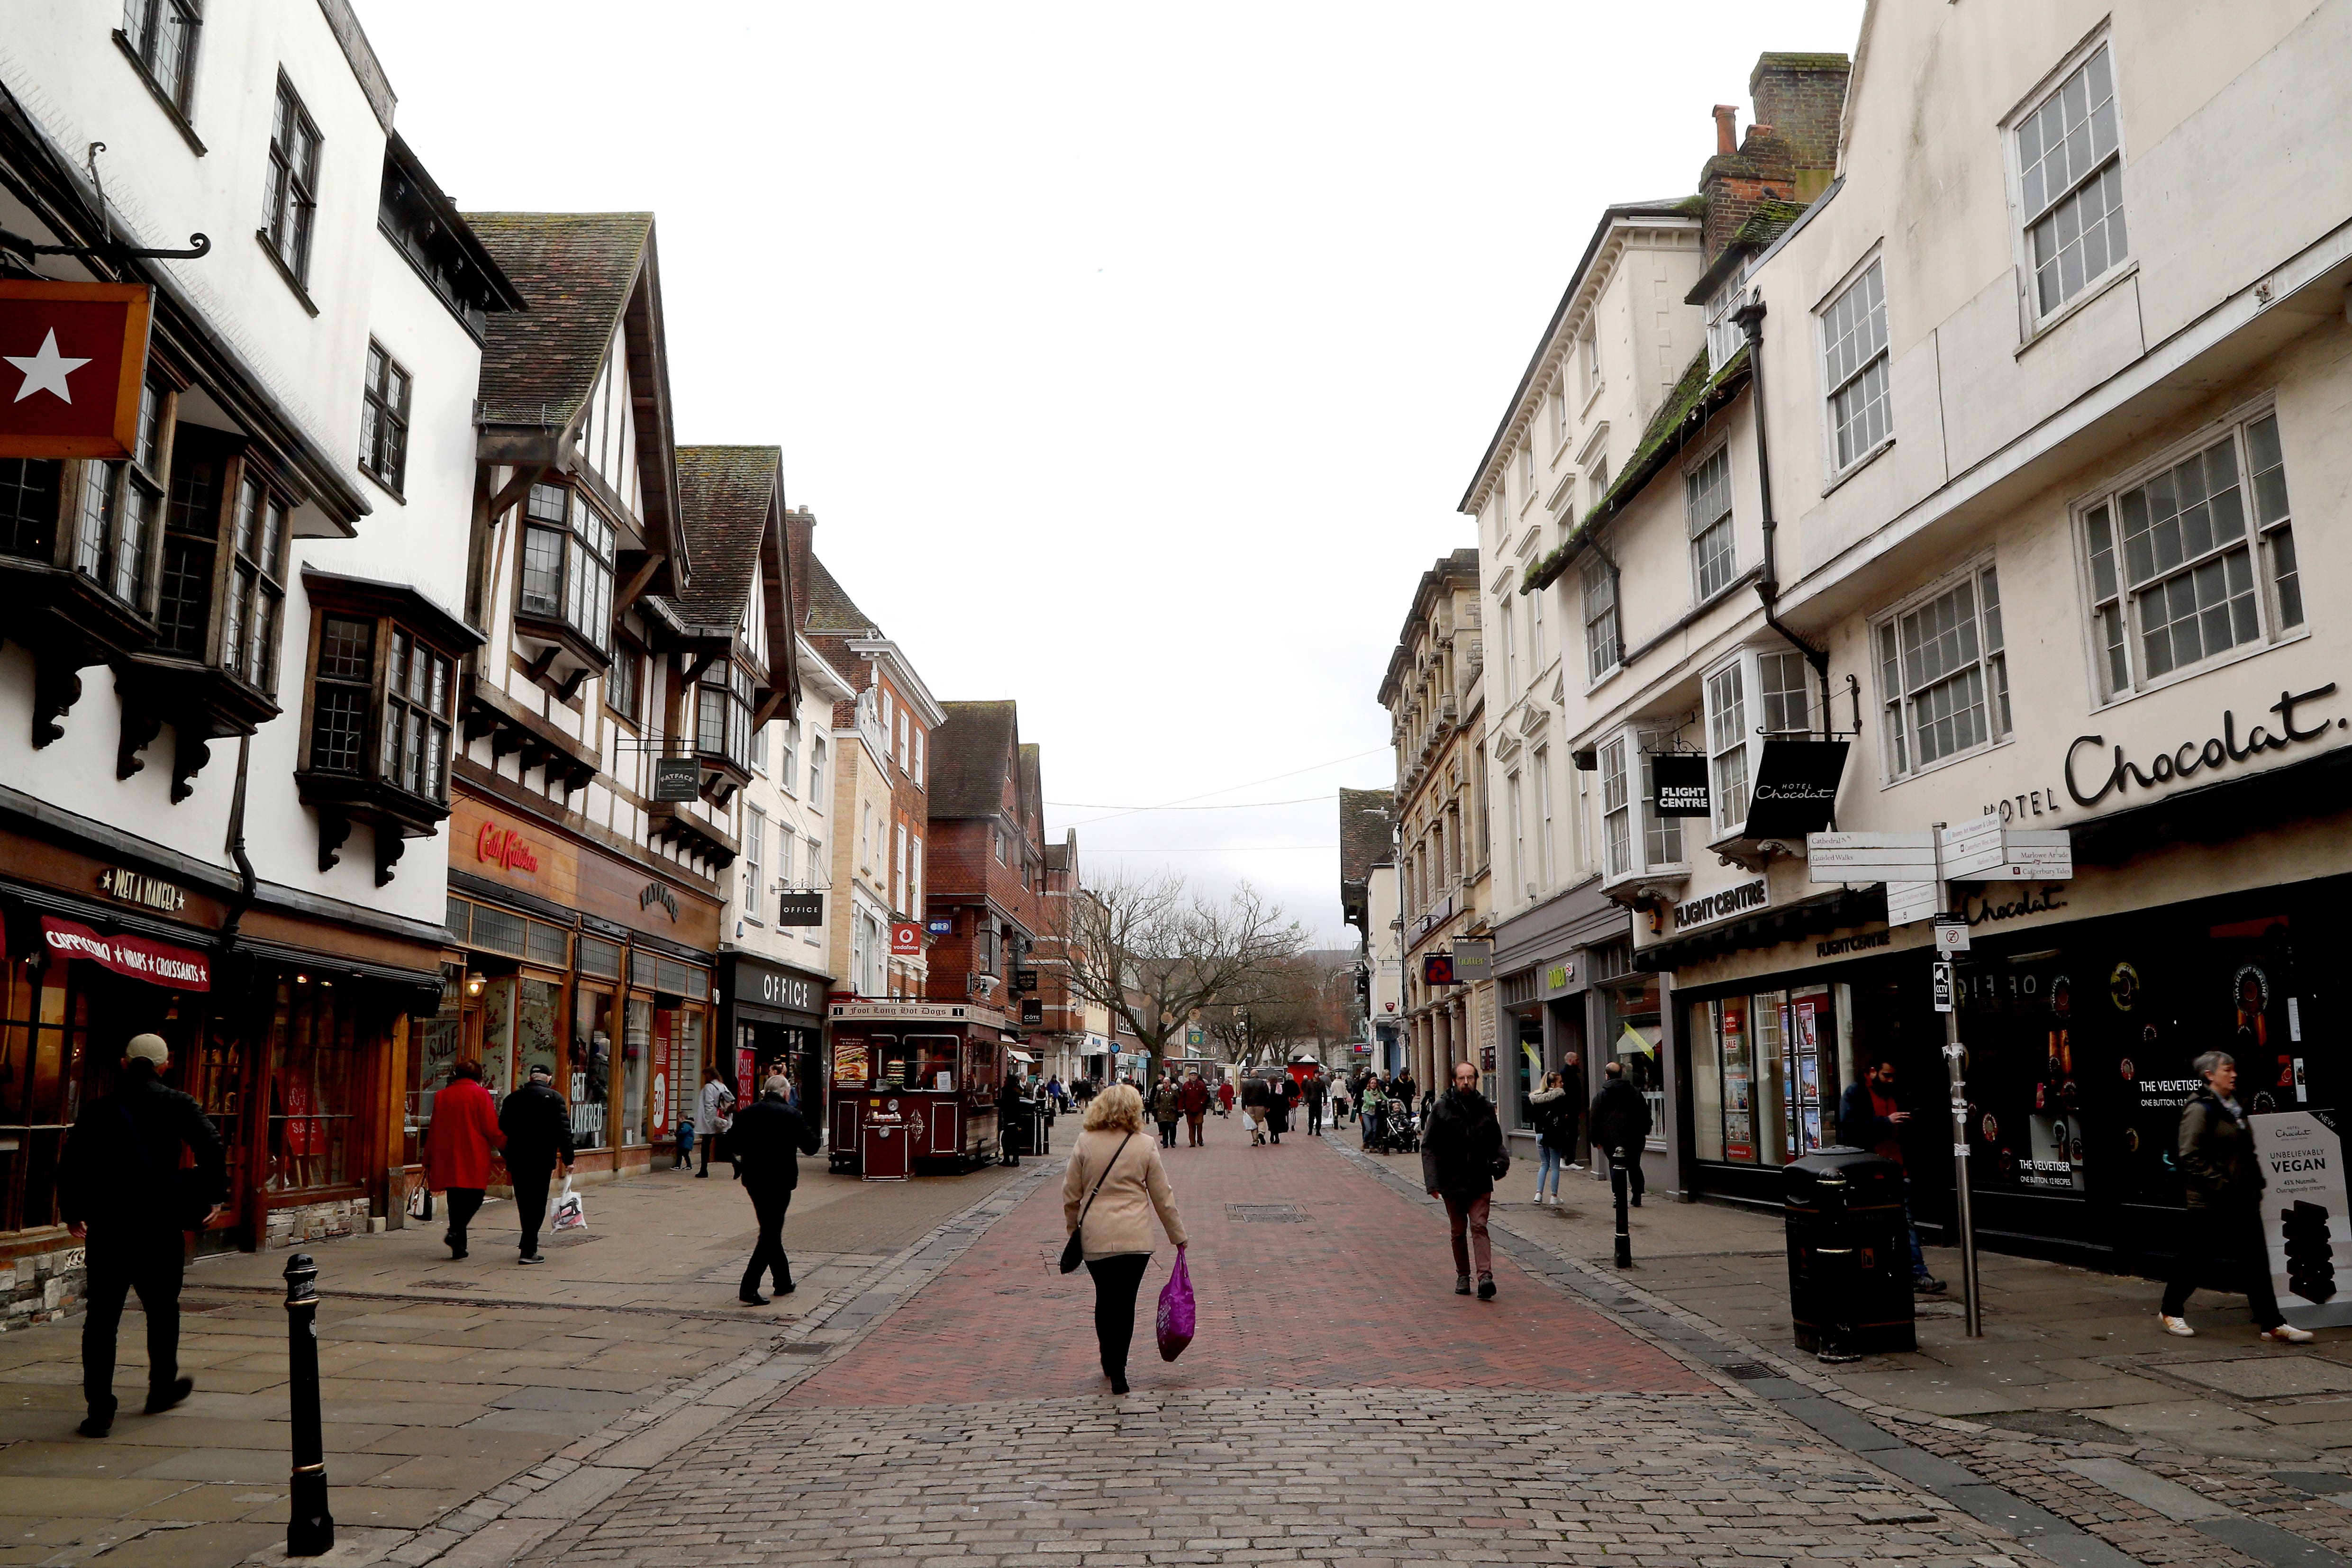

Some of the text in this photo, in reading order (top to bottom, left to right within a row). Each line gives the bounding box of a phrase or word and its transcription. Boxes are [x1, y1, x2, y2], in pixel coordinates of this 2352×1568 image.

[2064, 682, 2348, 807] Chocolat.
[660, 773, 694, 782] FATFACE
[1662, 787, 1706, 797] FLIGHT
[1756, 786, 1834, 799] Chocolat.
[1659, 798, 1708, 807] CENTRE
[1969, 825, 1983, 833] Museum
[1987, 819, 1998, 827] Library
[478, 821, 538, 872] Cath Kidston
[114, 868, 175, 911] PRET A MANGER
[639, 882, 679, 924] FATFACE
[1674, 879, 1766, 928] FLIGHT CENTRE
[1816, 929, 1890, 958] FLIGHT CENTRE
[46, 931, 199, 982] CAPPUCCINO WRAPS CROISSANTS
[1458, 957, 1486, 966] hotter
[763, 974, 808, 1007] OFFICE
[1936, 985, 1948, 993] CCTV
[2235, 967, 2252, 999] HAZELNUT
[849, 1007, 870, 1015] Foot
[872, 1006, 897, 1015] Long
[899, 1006, 917, 1015] Hot
[920, 1007, 946, 1016] Dogs
[428, 1024, 458, 1066] SALE
[1726, 1040, 1736, 1049] SALE
[740, 1059, 752, 1076] SALE
[571, 1072, 586, 1101] GET
[740, 1079, 751, 1097] SALE
[2139, 1081, 2156, 1091] THE
[571, 1103, 603, 1133] LAYERED
[2318, 1113, 2336, 1127] NEW
[2270, 1149, 2325, 1159] UNBELIEVABLY
[2019, 1160, 2071, 1172] THE VELVETISER
[2271, 1158, 2325, 1173] VEGAN
[2276, 1186, 2307, 1194] Outrageously
